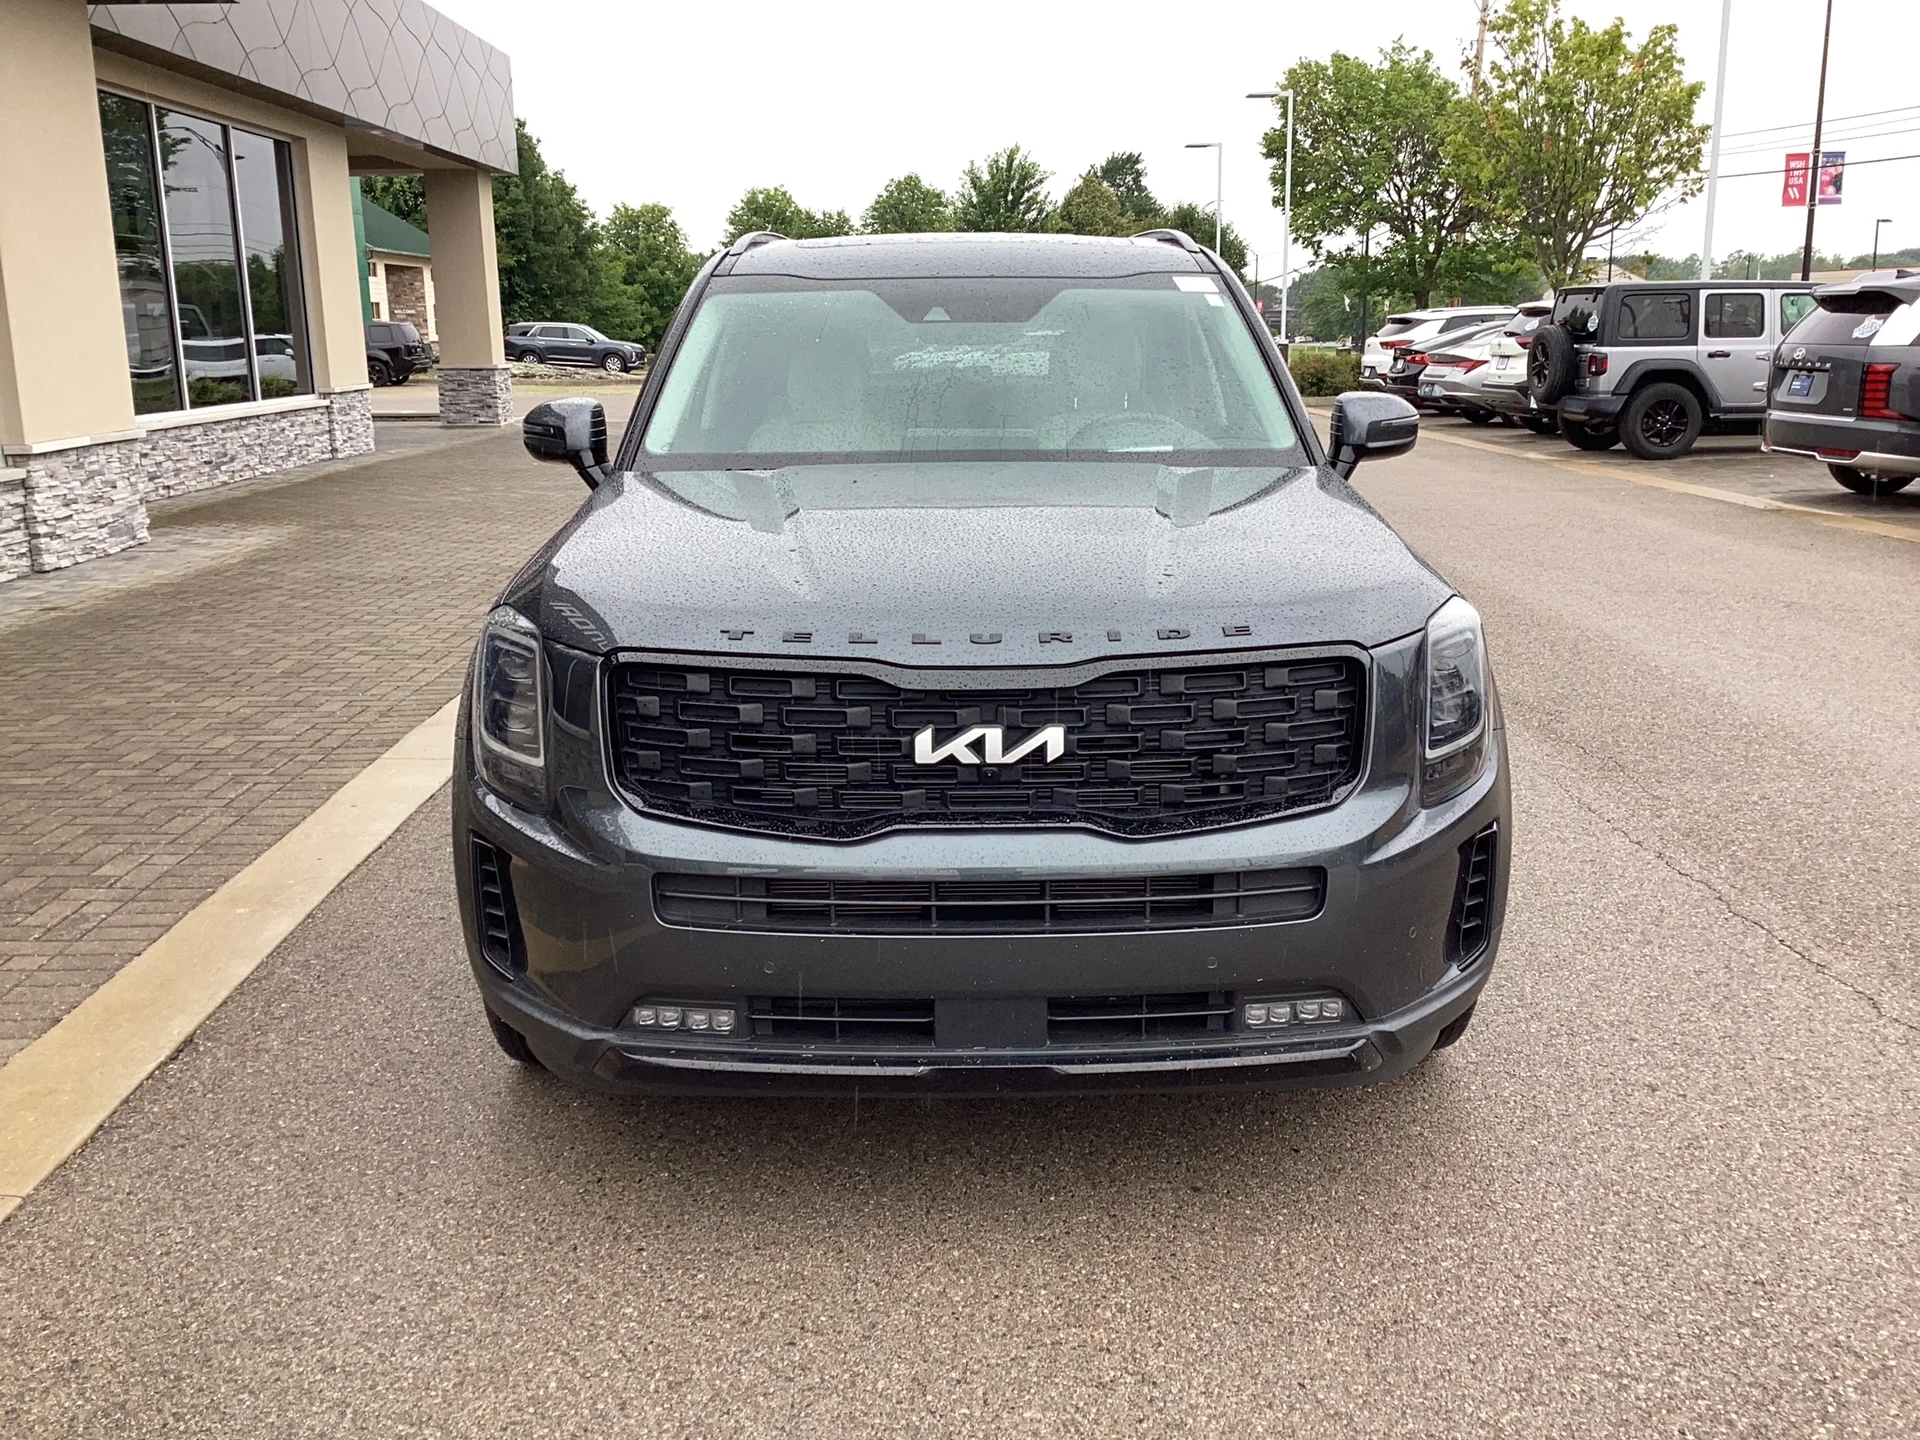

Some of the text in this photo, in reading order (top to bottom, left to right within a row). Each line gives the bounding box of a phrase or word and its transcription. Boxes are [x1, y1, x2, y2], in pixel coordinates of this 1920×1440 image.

[1789, 160, 1806, 169] WSH
[1788, 176, 1804, 185] USA
[719, 625, 1253, 645] TELLURIDE
[914, 727, 1064, 764] KIA
